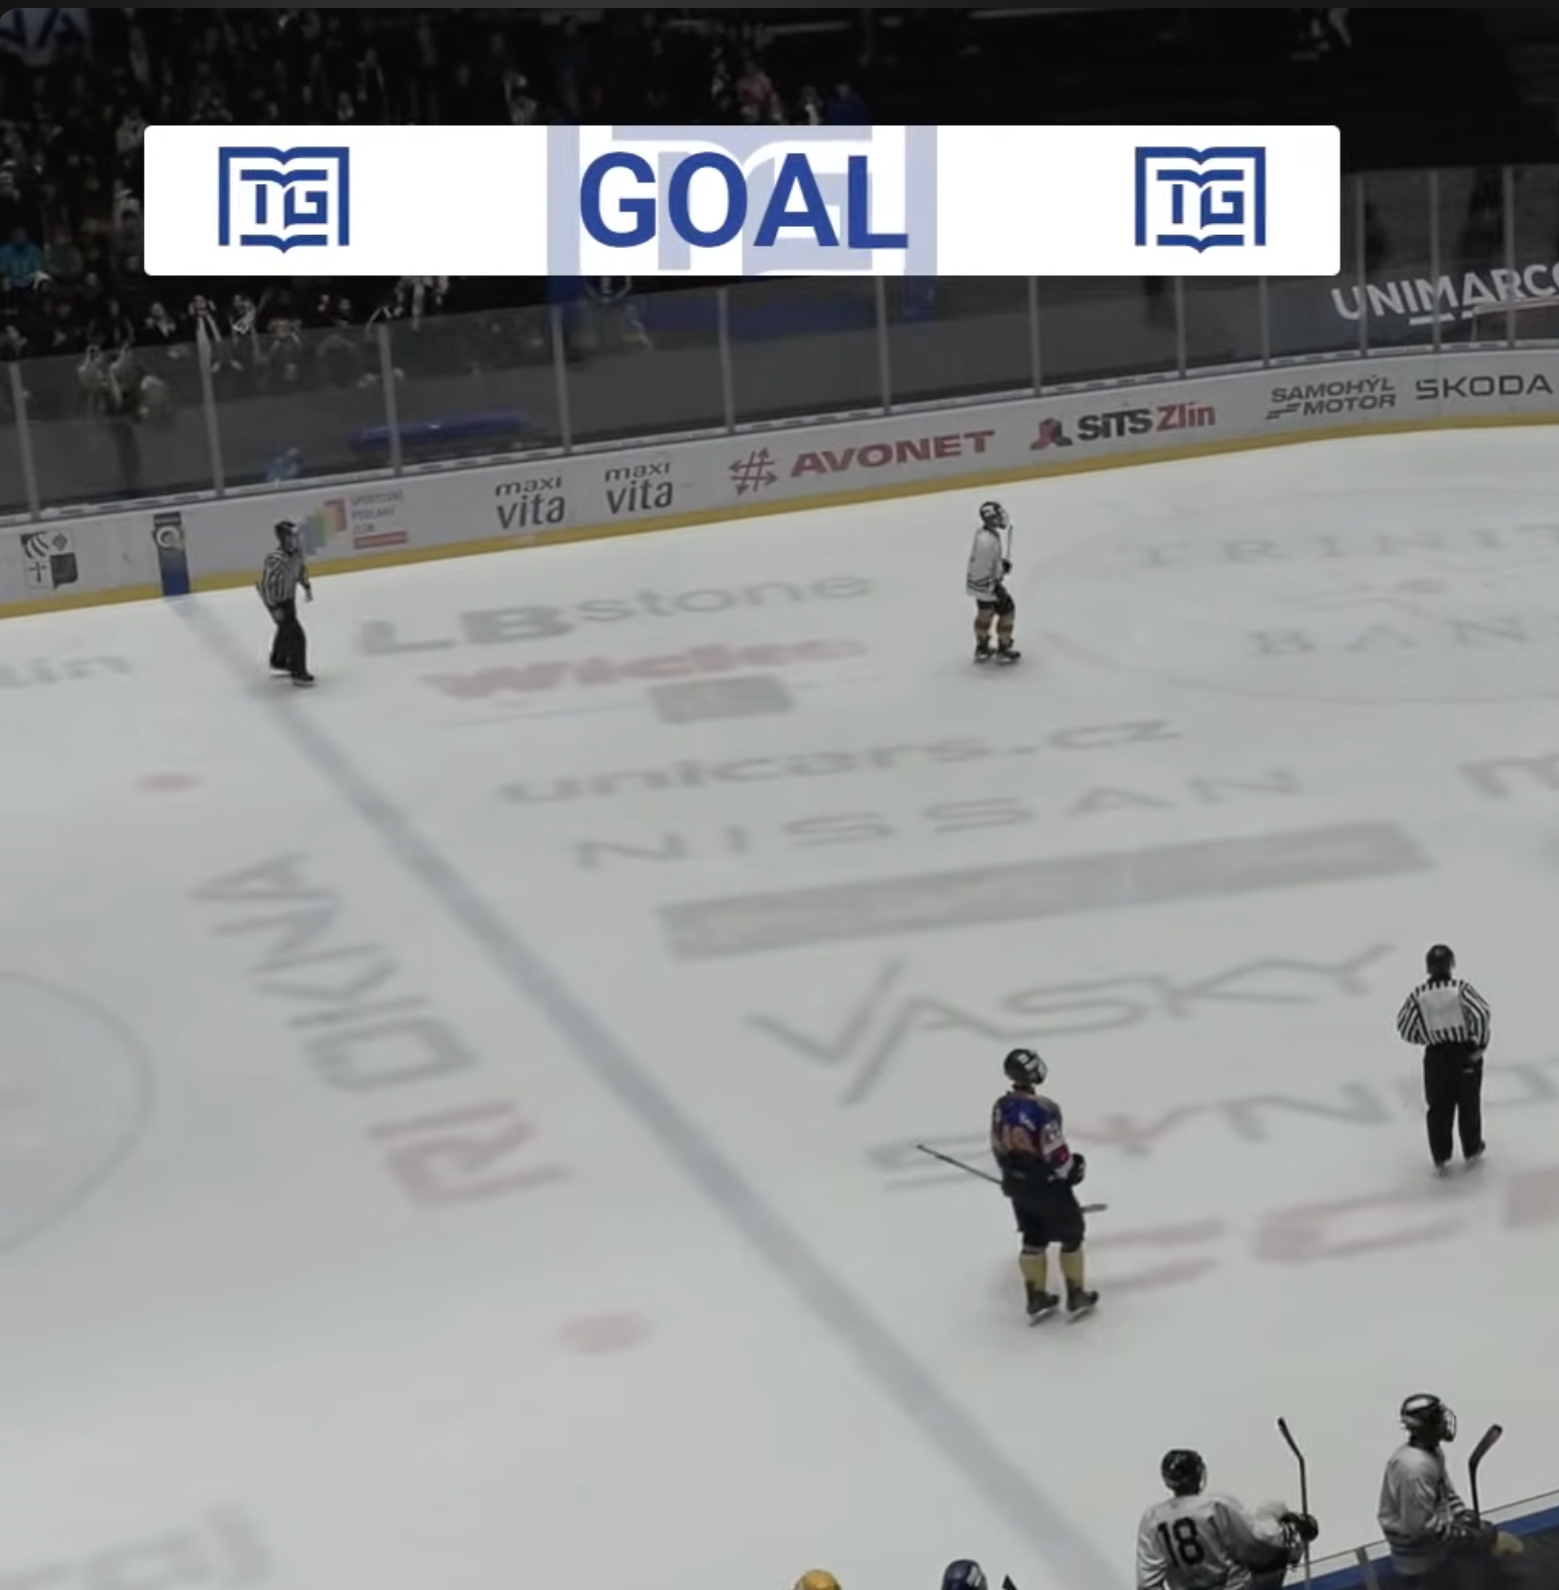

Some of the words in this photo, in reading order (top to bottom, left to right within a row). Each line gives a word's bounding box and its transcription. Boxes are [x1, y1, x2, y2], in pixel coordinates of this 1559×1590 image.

[1303, 395, 1396, 416] MOTOR
[605, 462, 671, 482] maxi
[790, 430, 995, 478] AVONET
[495, 476, 562, 496] maxi
[606, 479, 673, 515] vita
[496, 493, 566, 530] vita
[573, 768, 1304, 871] NISSAN
[748, 942, 1396, 1106] VASKY
[1156, 1515, 1205, 1568] 18
